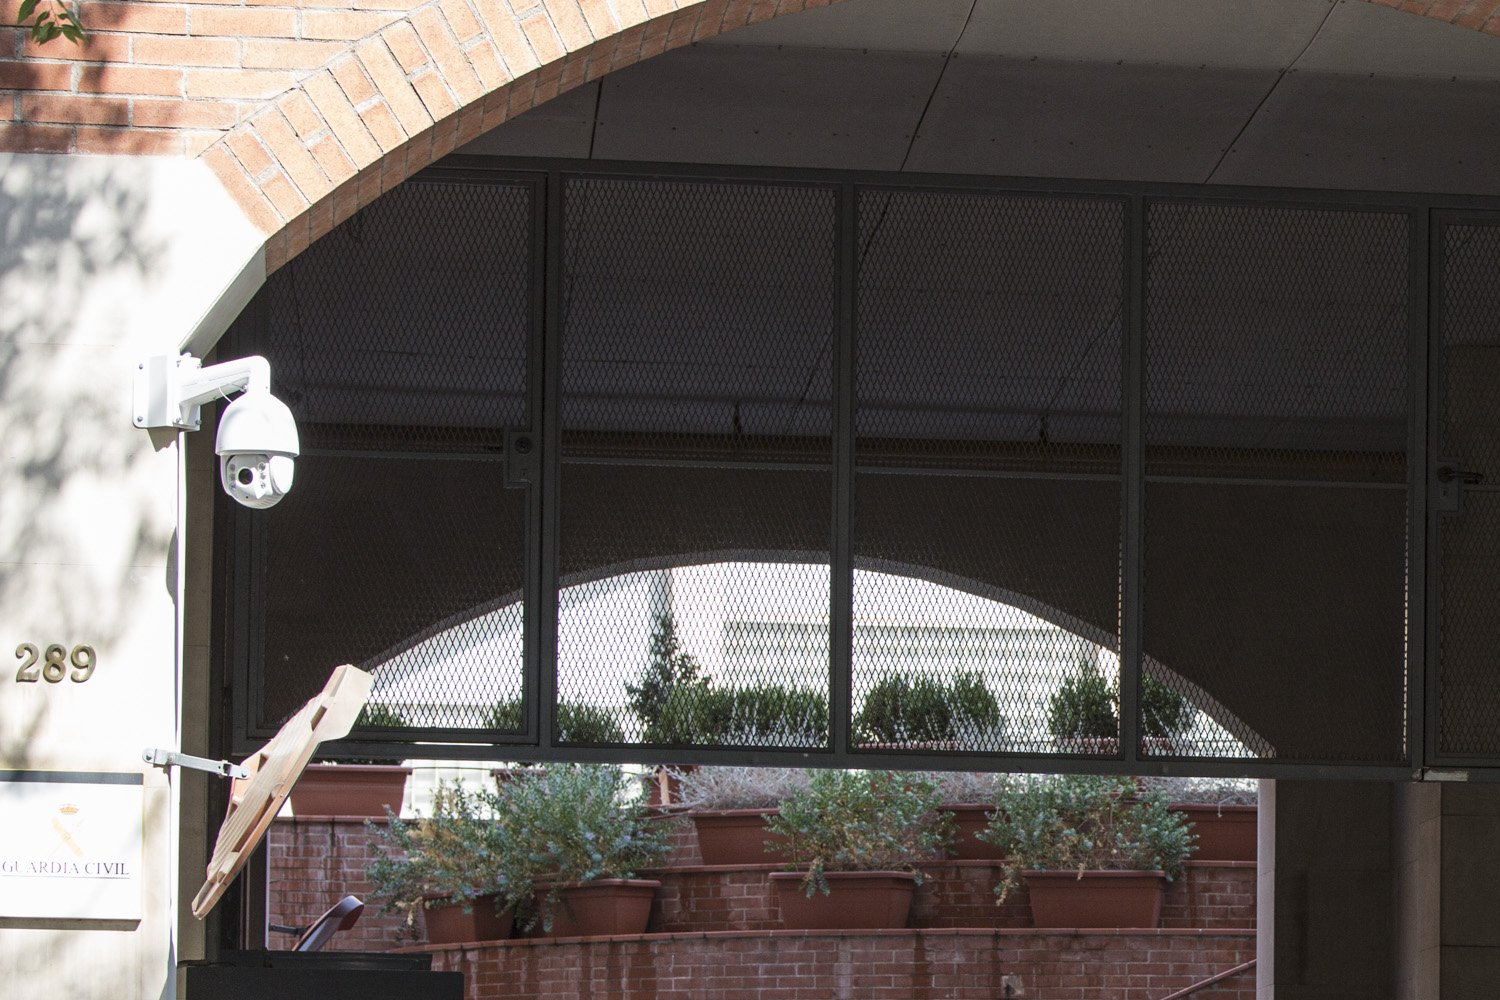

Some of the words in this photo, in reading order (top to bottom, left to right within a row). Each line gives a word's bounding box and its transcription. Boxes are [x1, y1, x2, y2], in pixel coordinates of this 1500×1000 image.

[15, 642, 97, 684] 289
[2, 860, 80, 875] GUARDIA
[84, 862, 130, 875] CIVIL
